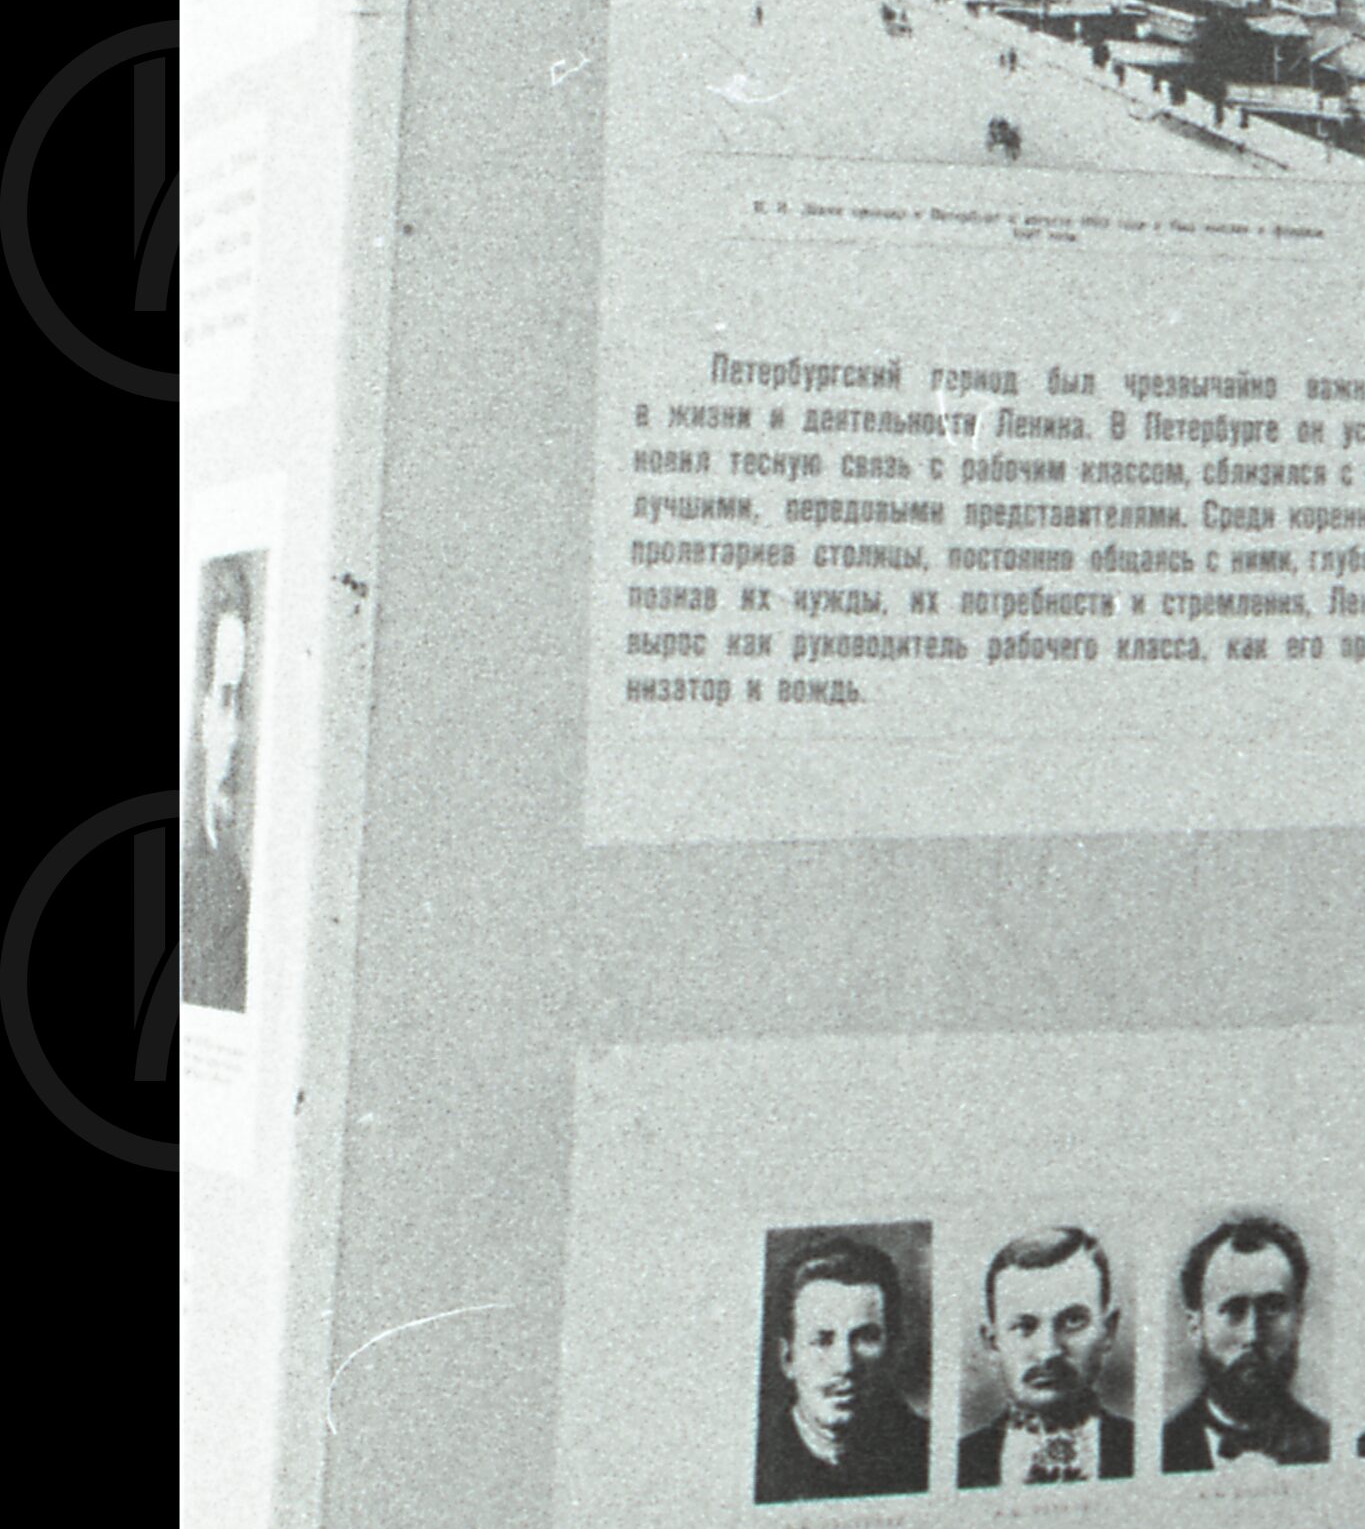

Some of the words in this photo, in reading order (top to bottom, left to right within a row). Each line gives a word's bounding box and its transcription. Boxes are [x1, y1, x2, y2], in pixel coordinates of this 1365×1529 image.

[634, 402, 650, 428] в
[769, 407, 786, 430] и
[1108, 408, 1127, 442] В
[928, 456, 945, 481] с
[1339, 463, 1353, 488] с
[1205, 548, 1219, 574] с
[1130, 593, 1146, 616] и
[746, 678, 762, 702] и
